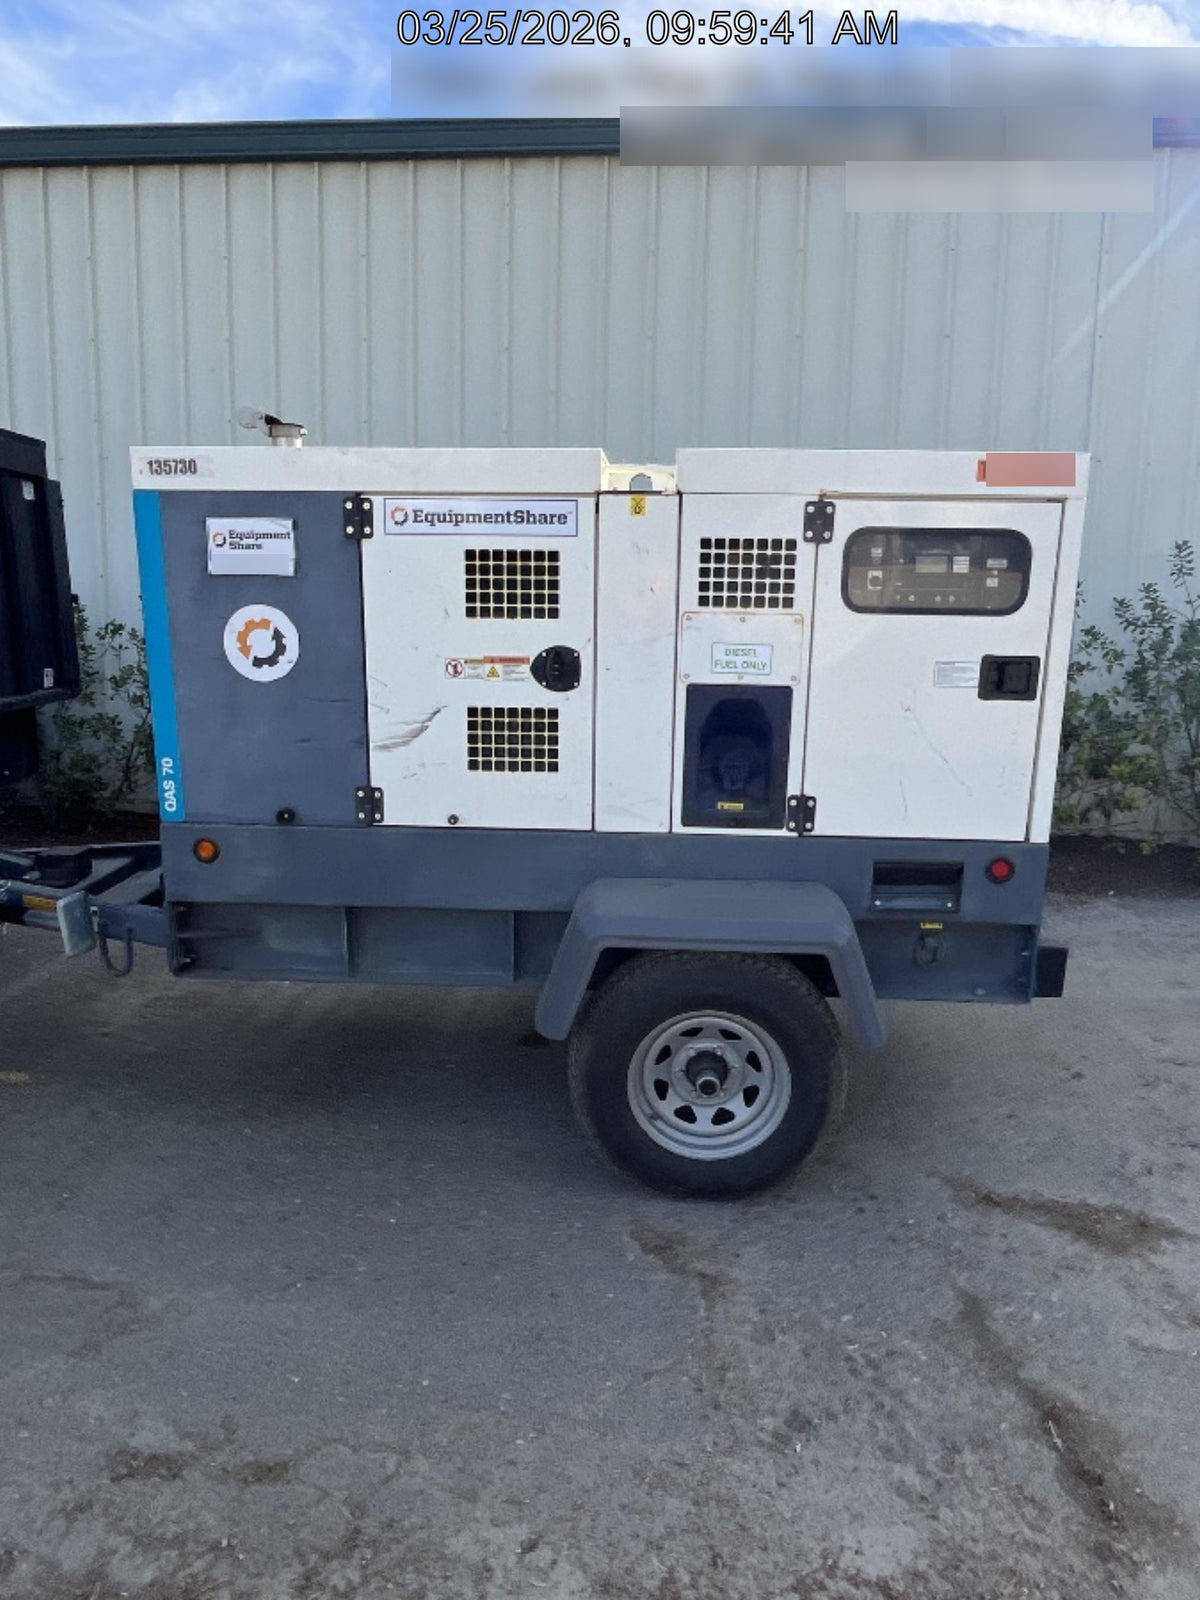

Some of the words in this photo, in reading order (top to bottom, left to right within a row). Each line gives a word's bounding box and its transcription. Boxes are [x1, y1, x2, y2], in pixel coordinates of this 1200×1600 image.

[147, 459, 197, 475] 135730
[412, 508, 568, 527] EquipmentShare
[228, 530, 291, 541] Equipment
[228, 541, 263, 550] Share
[725, 648, 758, 657] DIESEL
[714, 660, 739, 669] FUEL
[741, 661, 768, 671] ONLY
[161, 757, 174, 776] 70
[163, 780, 177, 812] QAS
